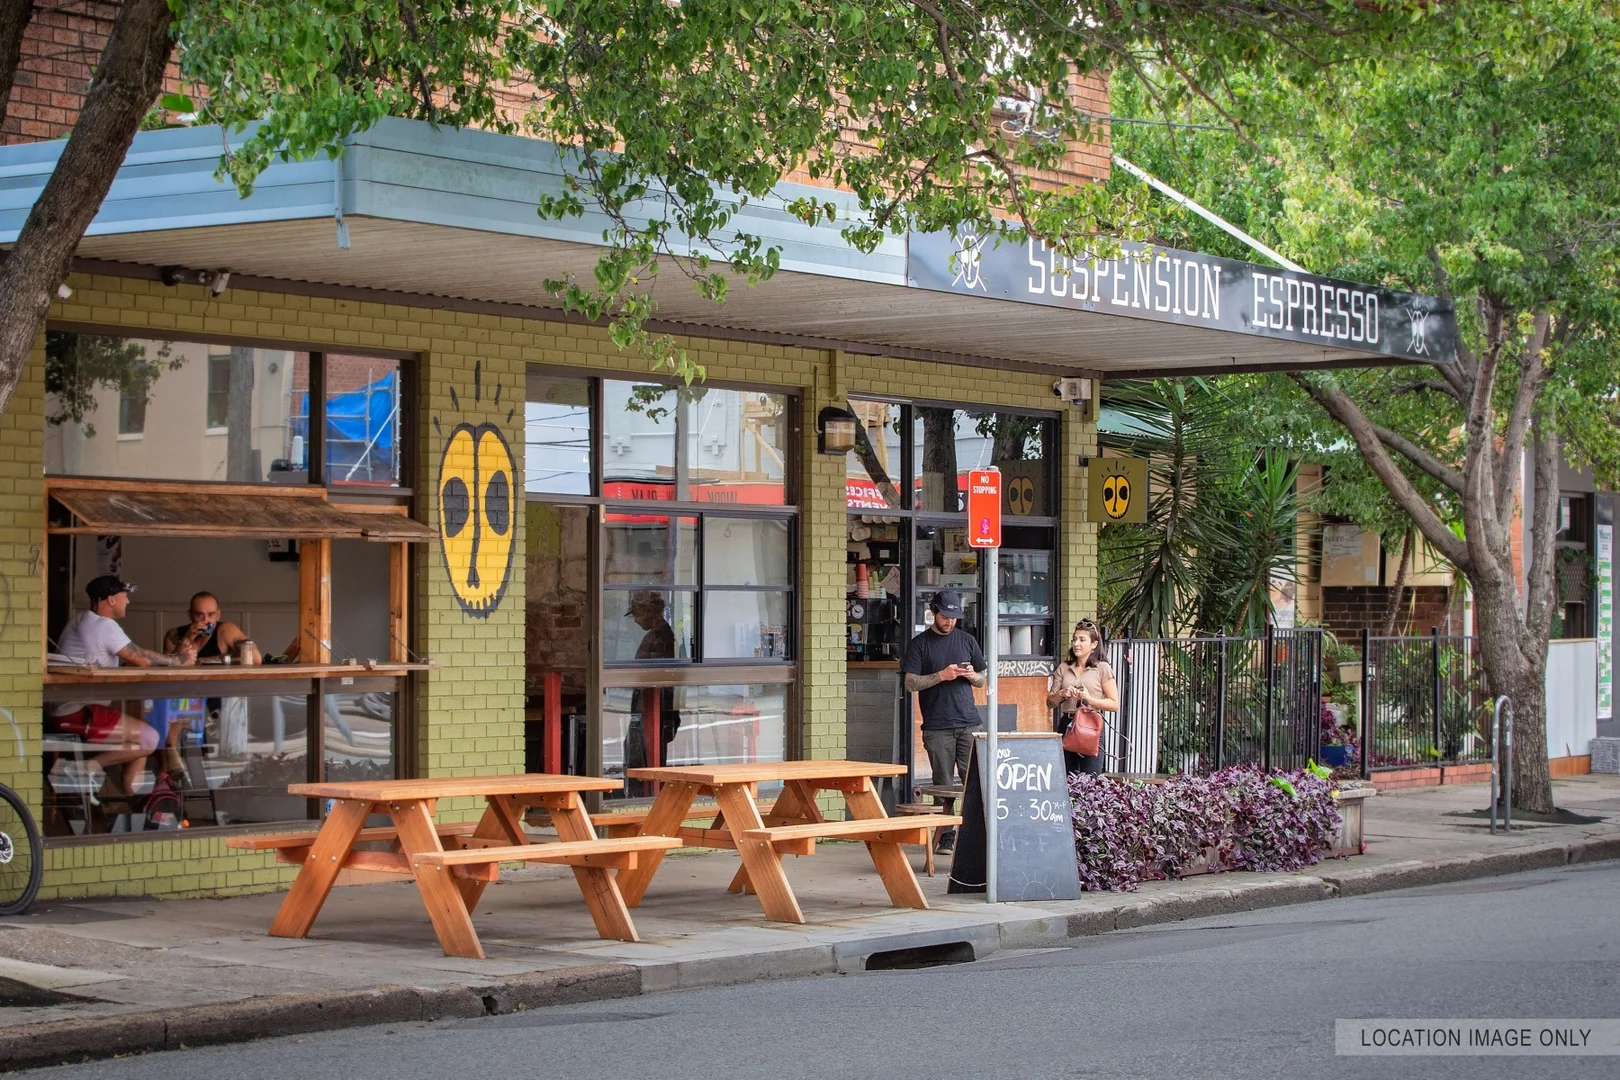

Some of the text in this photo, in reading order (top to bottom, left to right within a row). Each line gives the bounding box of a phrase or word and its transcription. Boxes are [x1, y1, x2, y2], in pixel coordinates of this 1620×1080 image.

[1027, 238, 1379, 344] SUSPENSION ESPRESSO
[980, 475, 990, 484] NO
[973, 486, 997, 495] STOPPING
[997, 762, 1053, 792] OPEN
